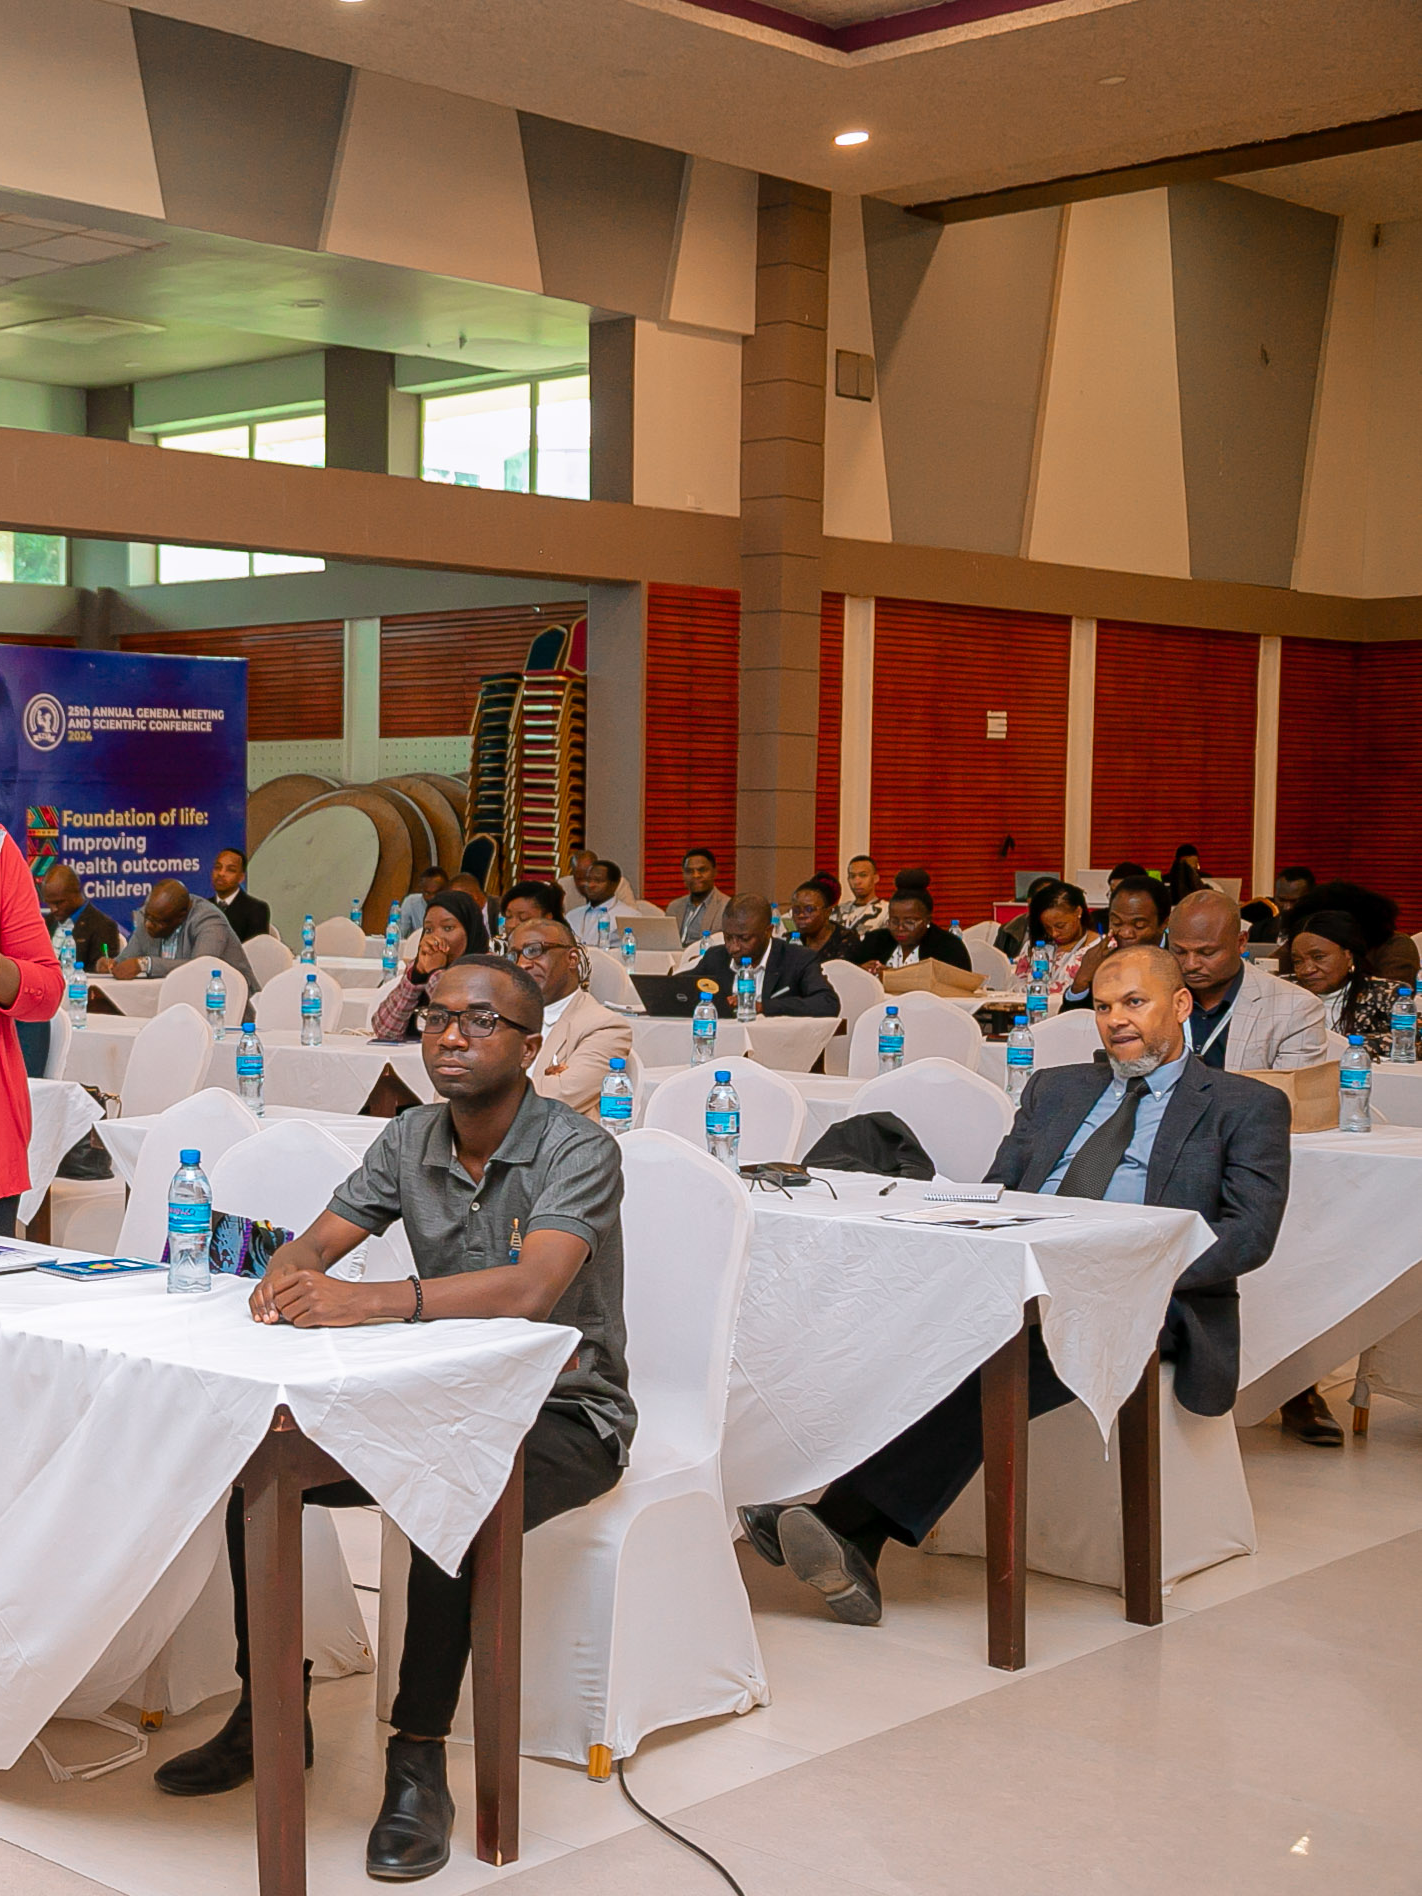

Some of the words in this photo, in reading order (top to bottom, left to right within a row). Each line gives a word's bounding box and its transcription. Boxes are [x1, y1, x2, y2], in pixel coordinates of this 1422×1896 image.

[67, 706, 91, 717] 25th
[92, 706, 135, 718] ANNUAL
[136, 707, 181, 719] GENERAL
[183, 709, 225, 720] MEETING
[67, 718, 91, 729] AND
[93, 719, 147, 730] SCIENTIFIC
[149, 720, 213, 732] CONFERENCE
[67, 731, 93, 742] 2024
[62, 808, 157, 827] Foundation
[159, 808, 177, 825] of
[180, 807, 209, 825] life:
[62, 832, 147, 855] Improving
[122, 857, 200, 873] outcomes
